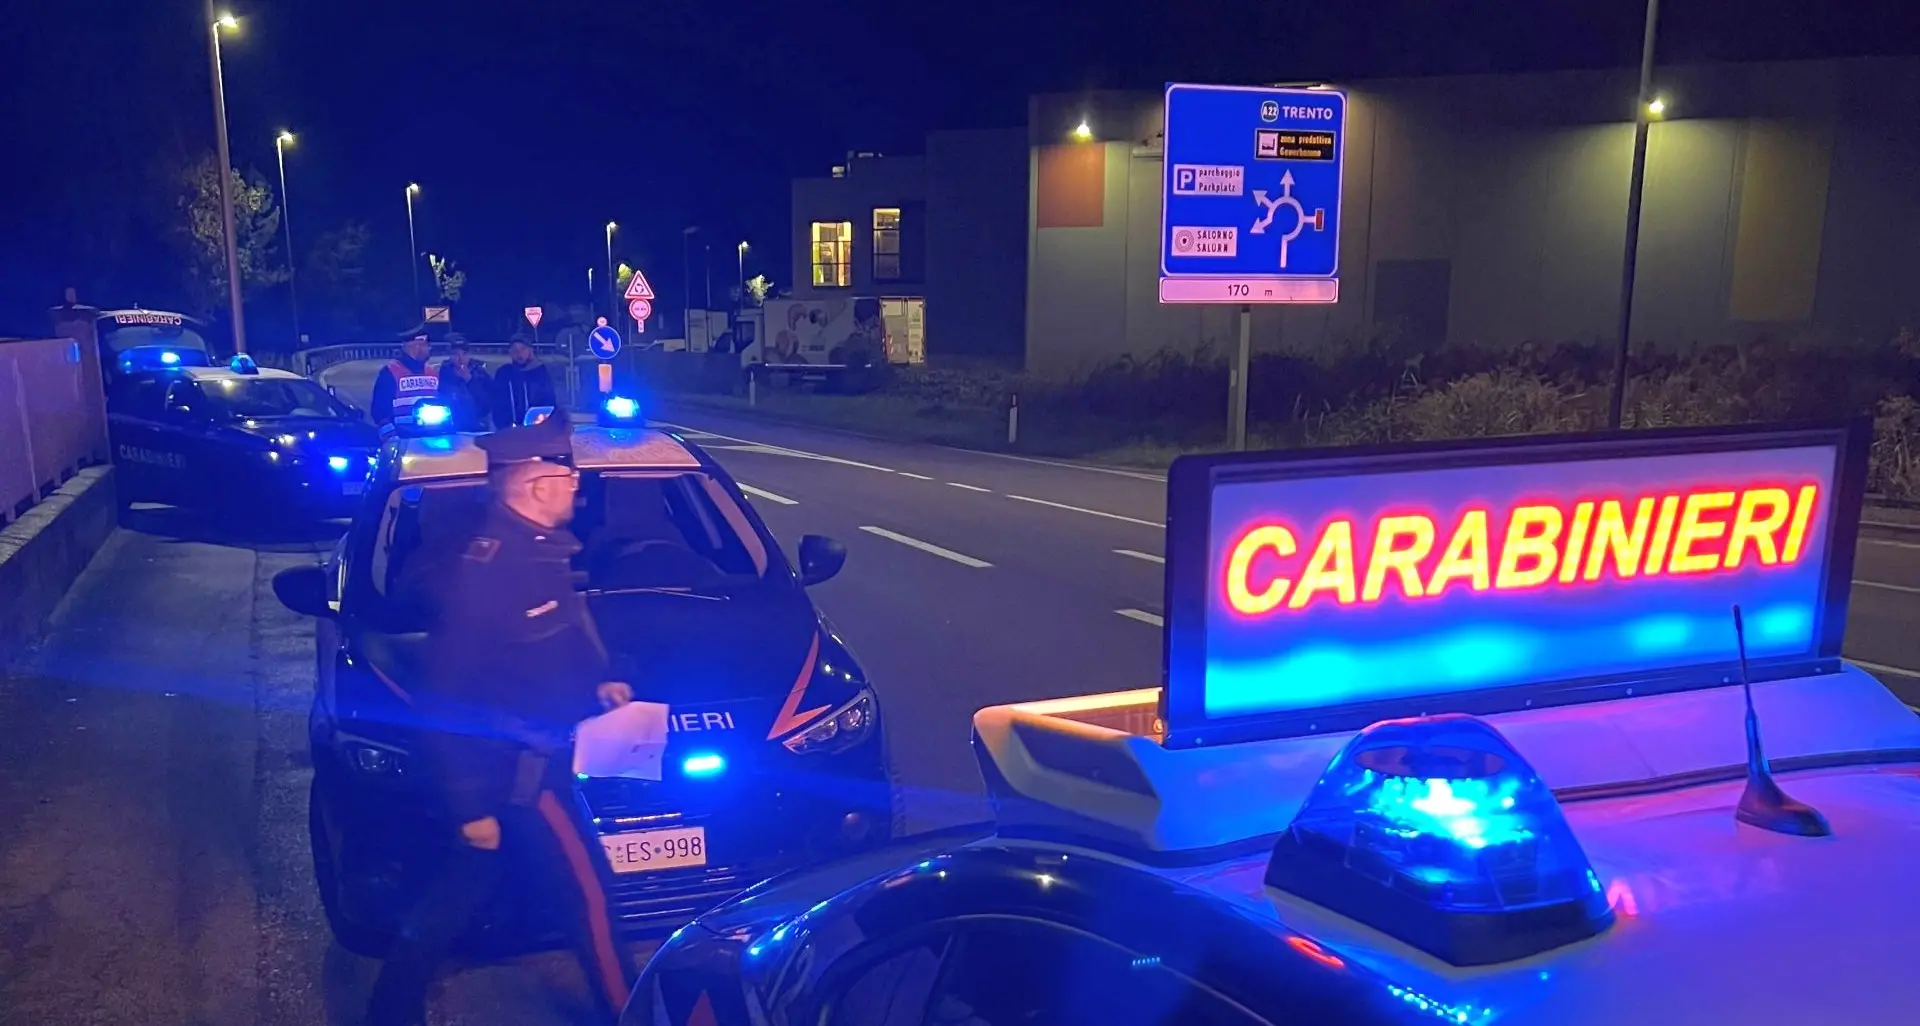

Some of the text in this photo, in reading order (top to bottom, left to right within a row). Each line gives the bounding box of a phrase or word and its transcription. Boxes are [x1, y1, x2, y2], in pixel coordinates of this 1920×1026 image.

[1262, 105, 1333, 120] A22 TRENTO
[1199, 168, 1240, 178] parcheggio
[1180, 170, 1193, 189] P
[1199, 182, 1236, 193] Parkplatz
[1197, 230, 1234, 240] SALORNO
[1196, 243, 1228, 252] SALURN
[1228, 284, 1249, 296] 170
[1225, 484, 1818, 616] CARABINIERI
[666, 711, 735, 733] IERI
